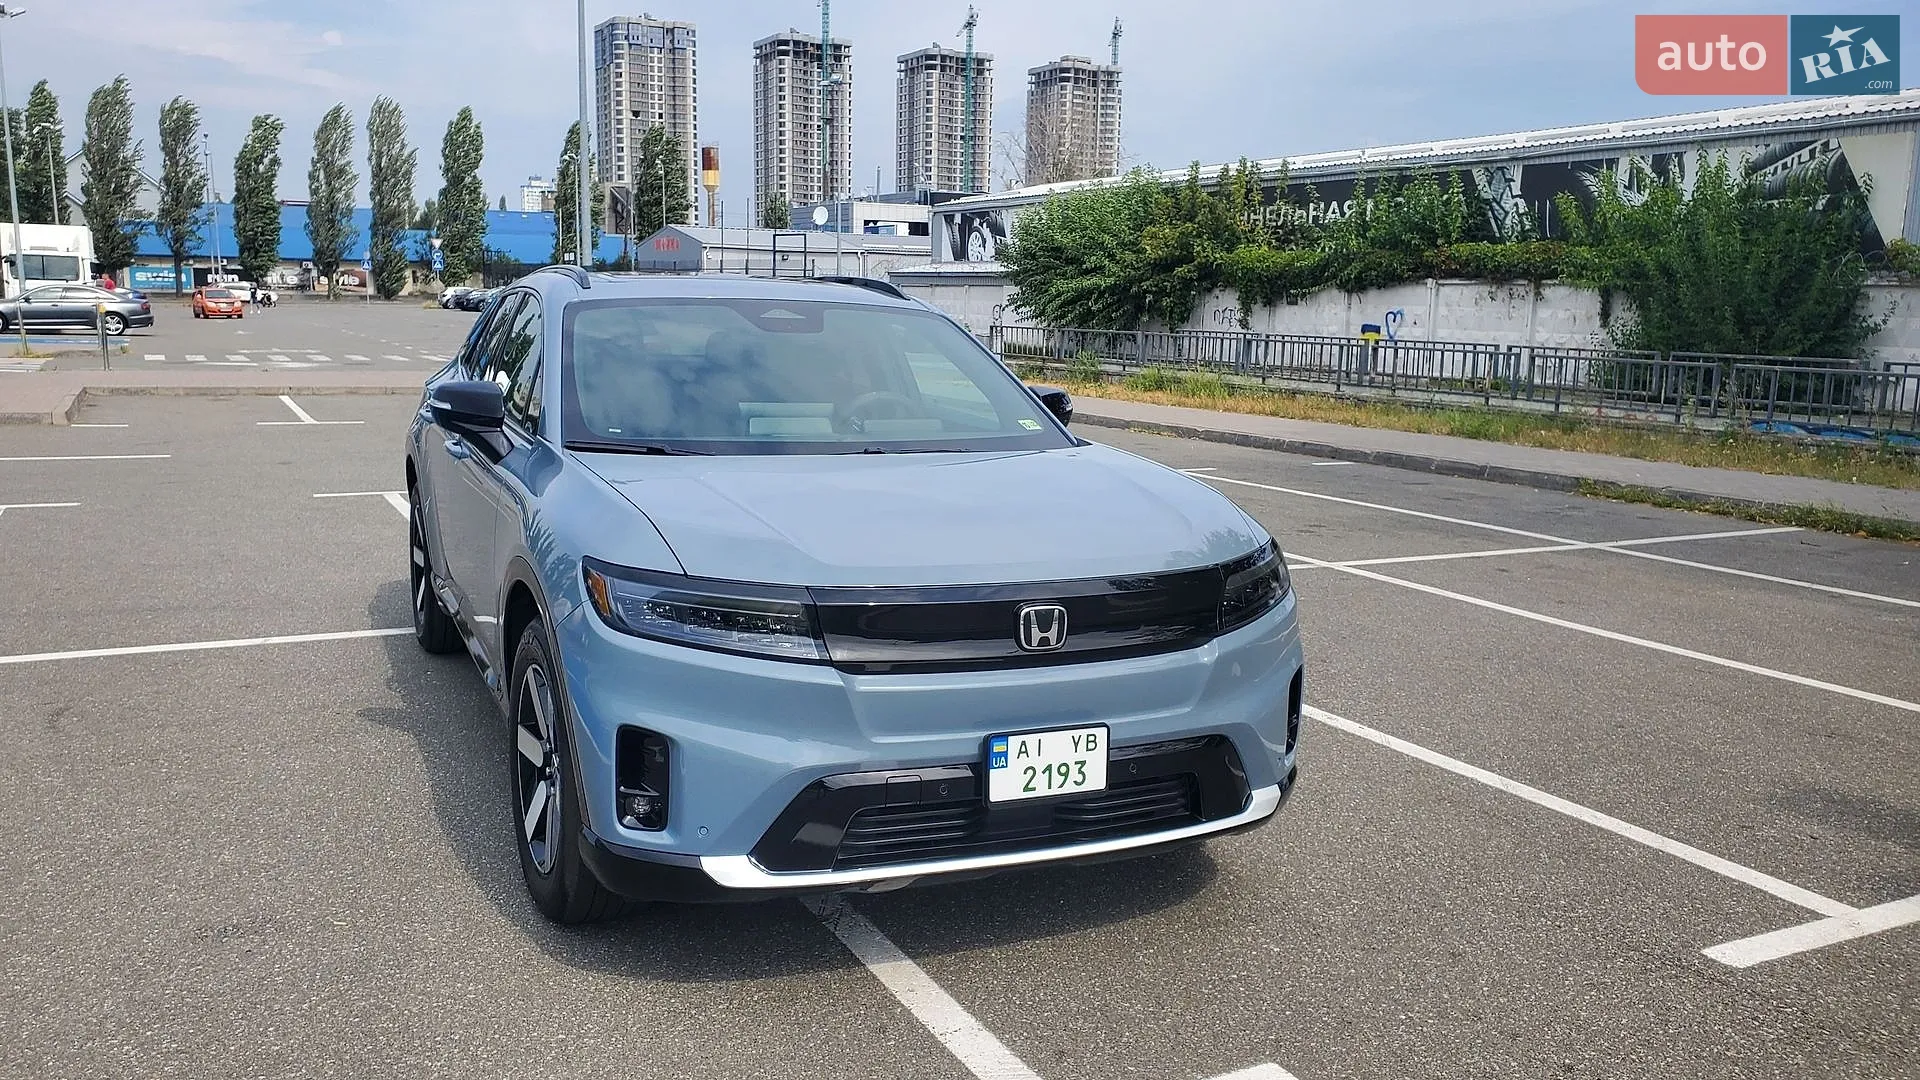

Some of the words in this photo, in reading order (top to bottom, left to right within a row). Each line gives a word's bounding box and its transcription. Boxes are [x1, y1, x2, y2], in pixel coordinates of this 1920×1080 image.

[1017, 738, 1042, 759] AI
[1072, 734, 1098, 753] YB
[992, 757, 1007, 767] UA
[1022, 760, 1087, 793] 2193
